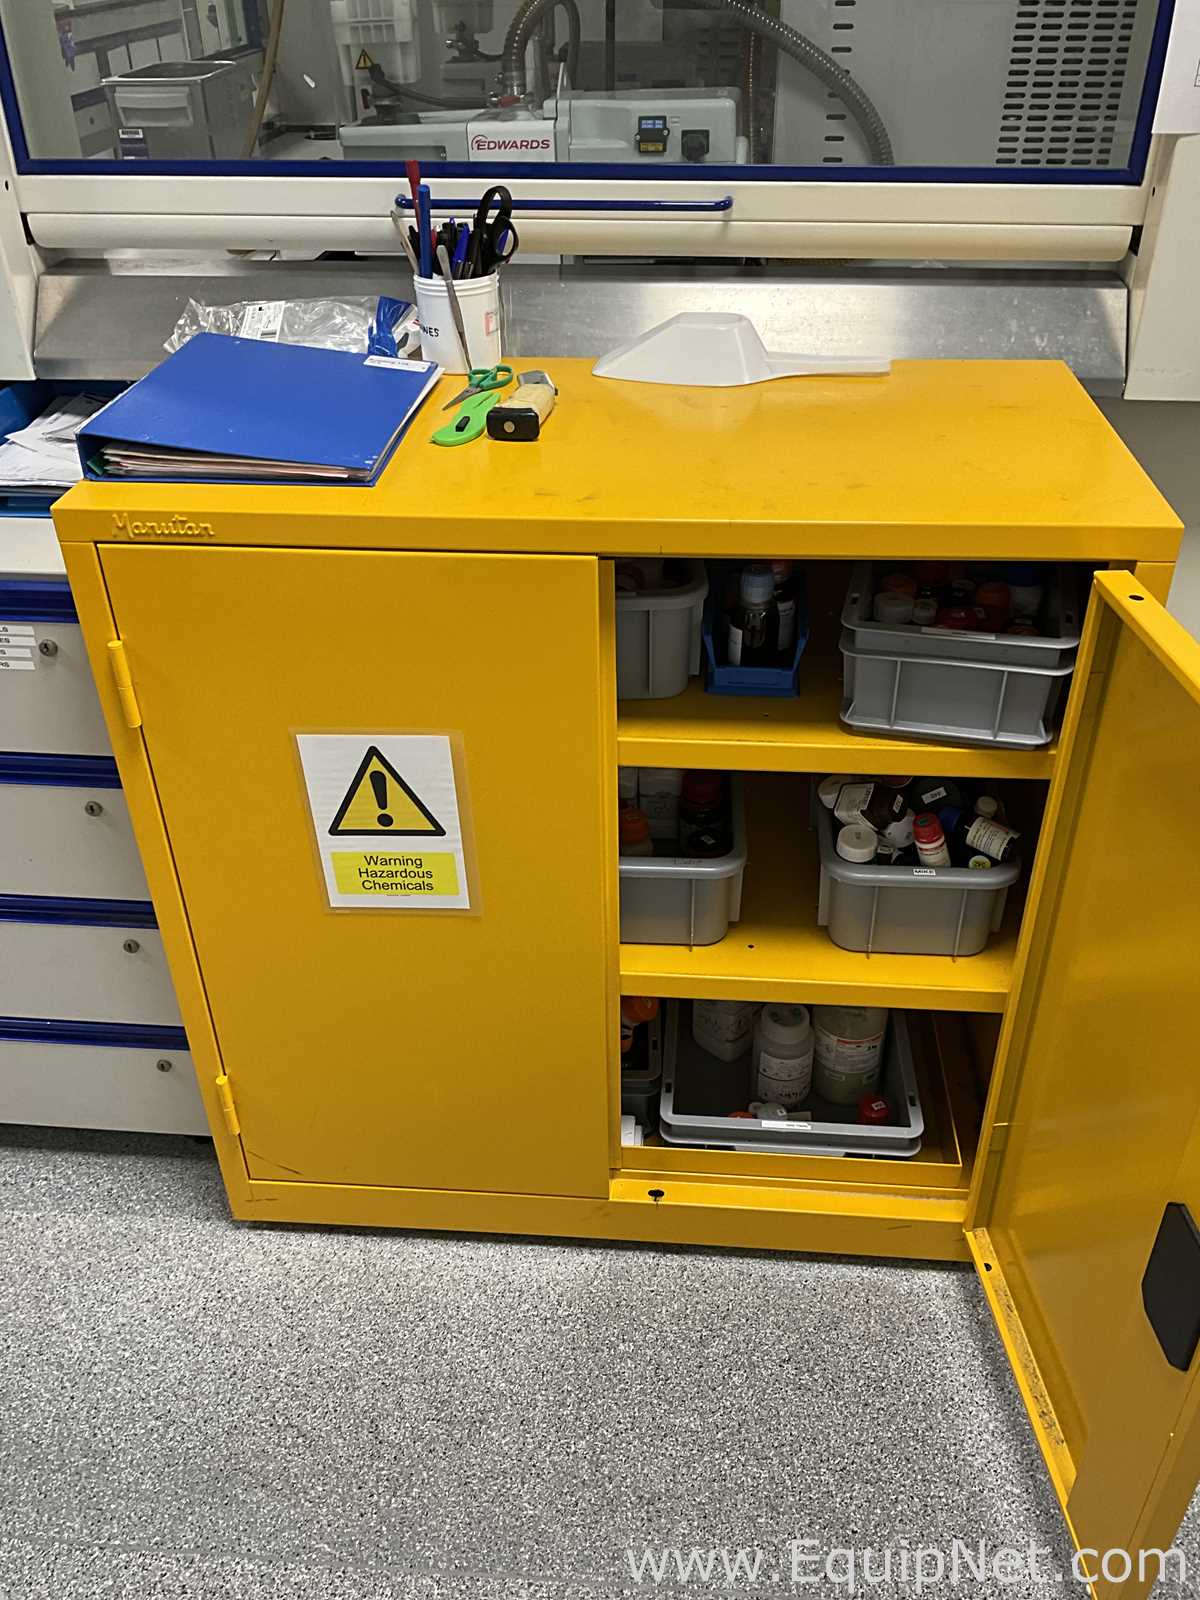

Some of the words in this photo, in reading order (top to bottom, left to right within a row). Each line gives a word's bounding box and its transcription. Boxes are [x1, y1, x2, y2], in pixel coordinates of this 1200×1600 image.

[475, 138, 551, 151] EDWARDS
[111, 512, 216, 540] Manutan
[363, 855, 423, 869] Warning
[358, 867, 433, 879] Hazardous
[361, 879, 434, 891] Chemicals
